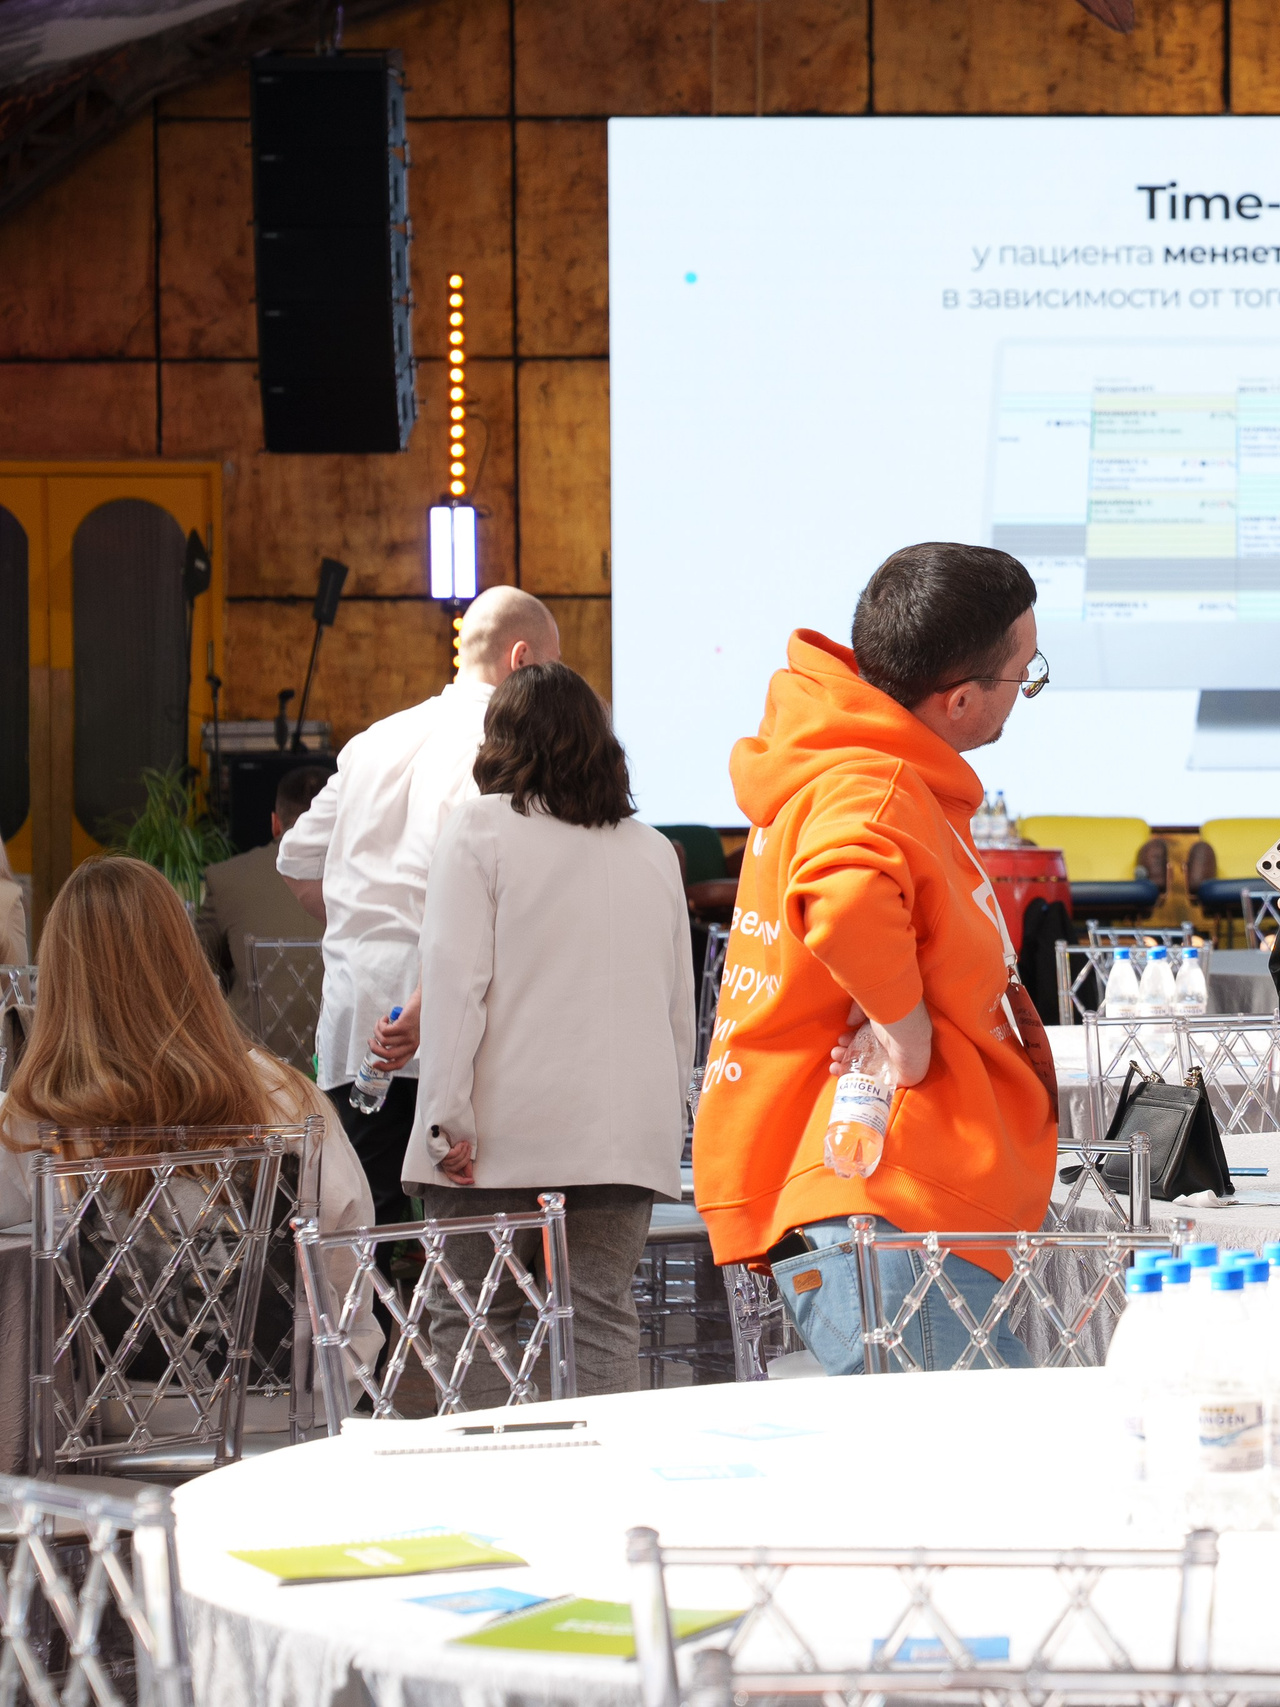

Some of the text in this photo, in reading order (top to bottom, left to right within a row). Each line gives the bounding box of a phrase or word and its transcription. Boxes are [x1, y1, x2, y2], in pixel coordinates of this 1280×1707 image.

[971, 246, 991, 272] у
[999, 244, 1155, 270] пациента
[942, 288, 960, 309] в
[969, 288, 1181, 309] зависимости
[1188, 288, 1223, 309] от
